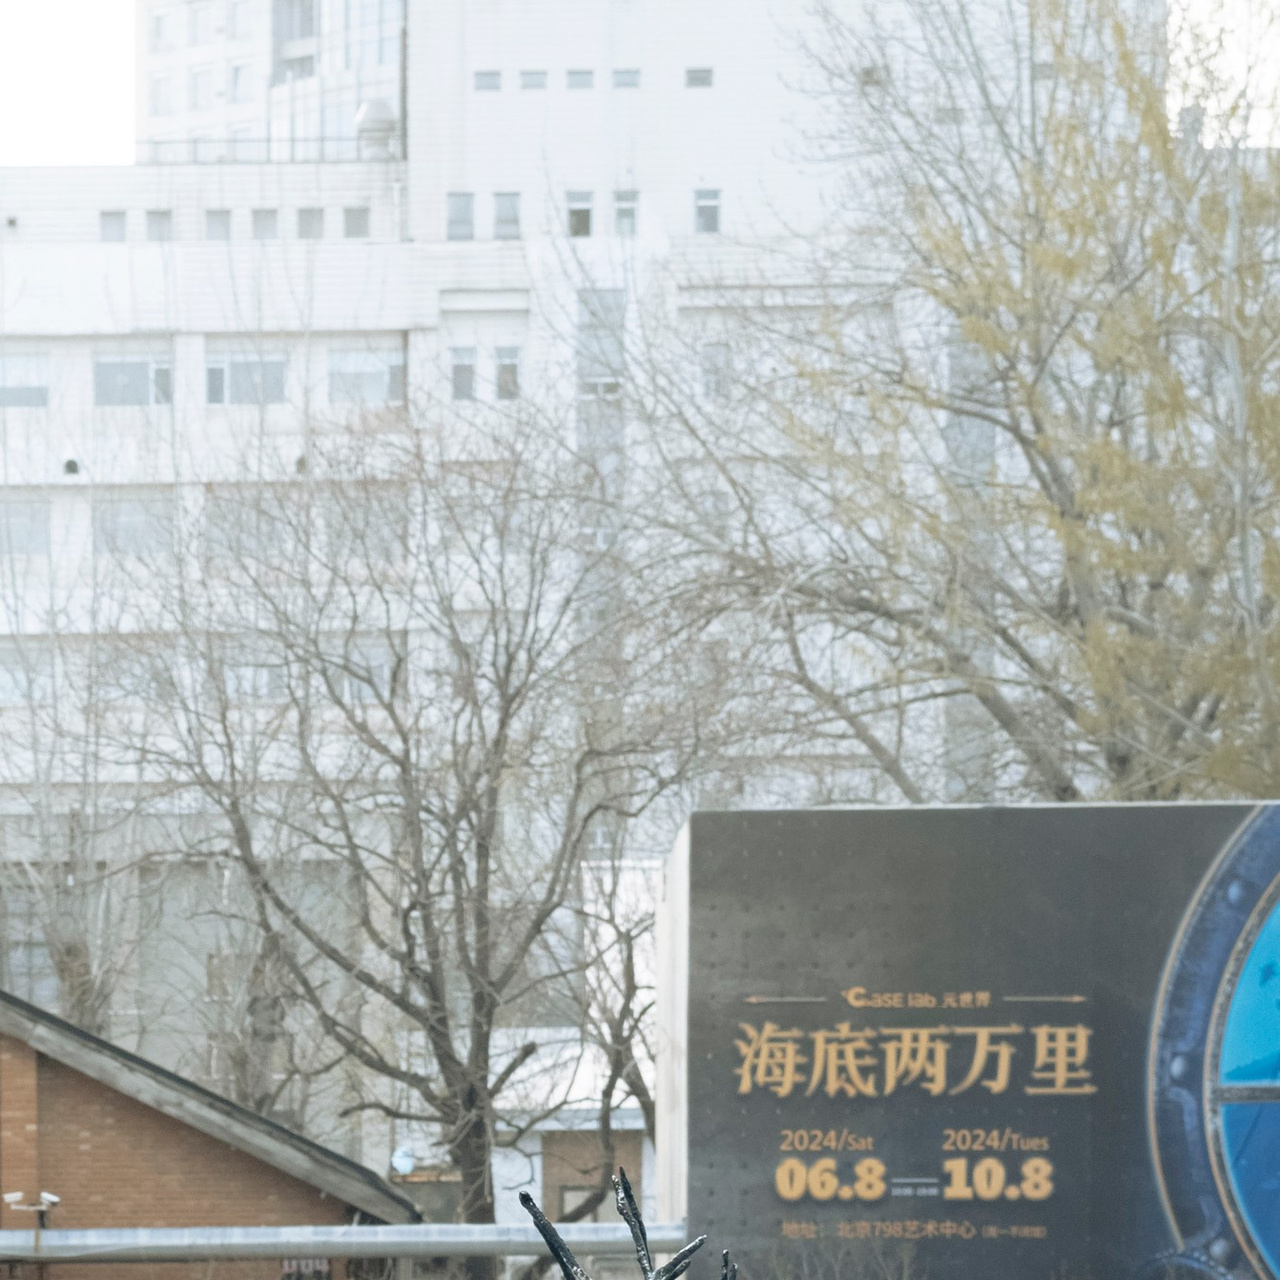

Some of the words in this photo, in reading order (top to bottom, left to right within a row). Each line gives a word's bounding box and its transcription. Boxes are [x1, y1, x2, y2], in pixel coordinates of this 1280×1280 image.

[733, 1021, 1098, 1098] 海底两万里
[780, 1128, 874, 1151] 2024/Sat
[942, 1127, 1050, 1151] 2024/Tues
[775, 1157, 887, 1200] 06.8
[942, 1157, 1054, 1200] 10.8
